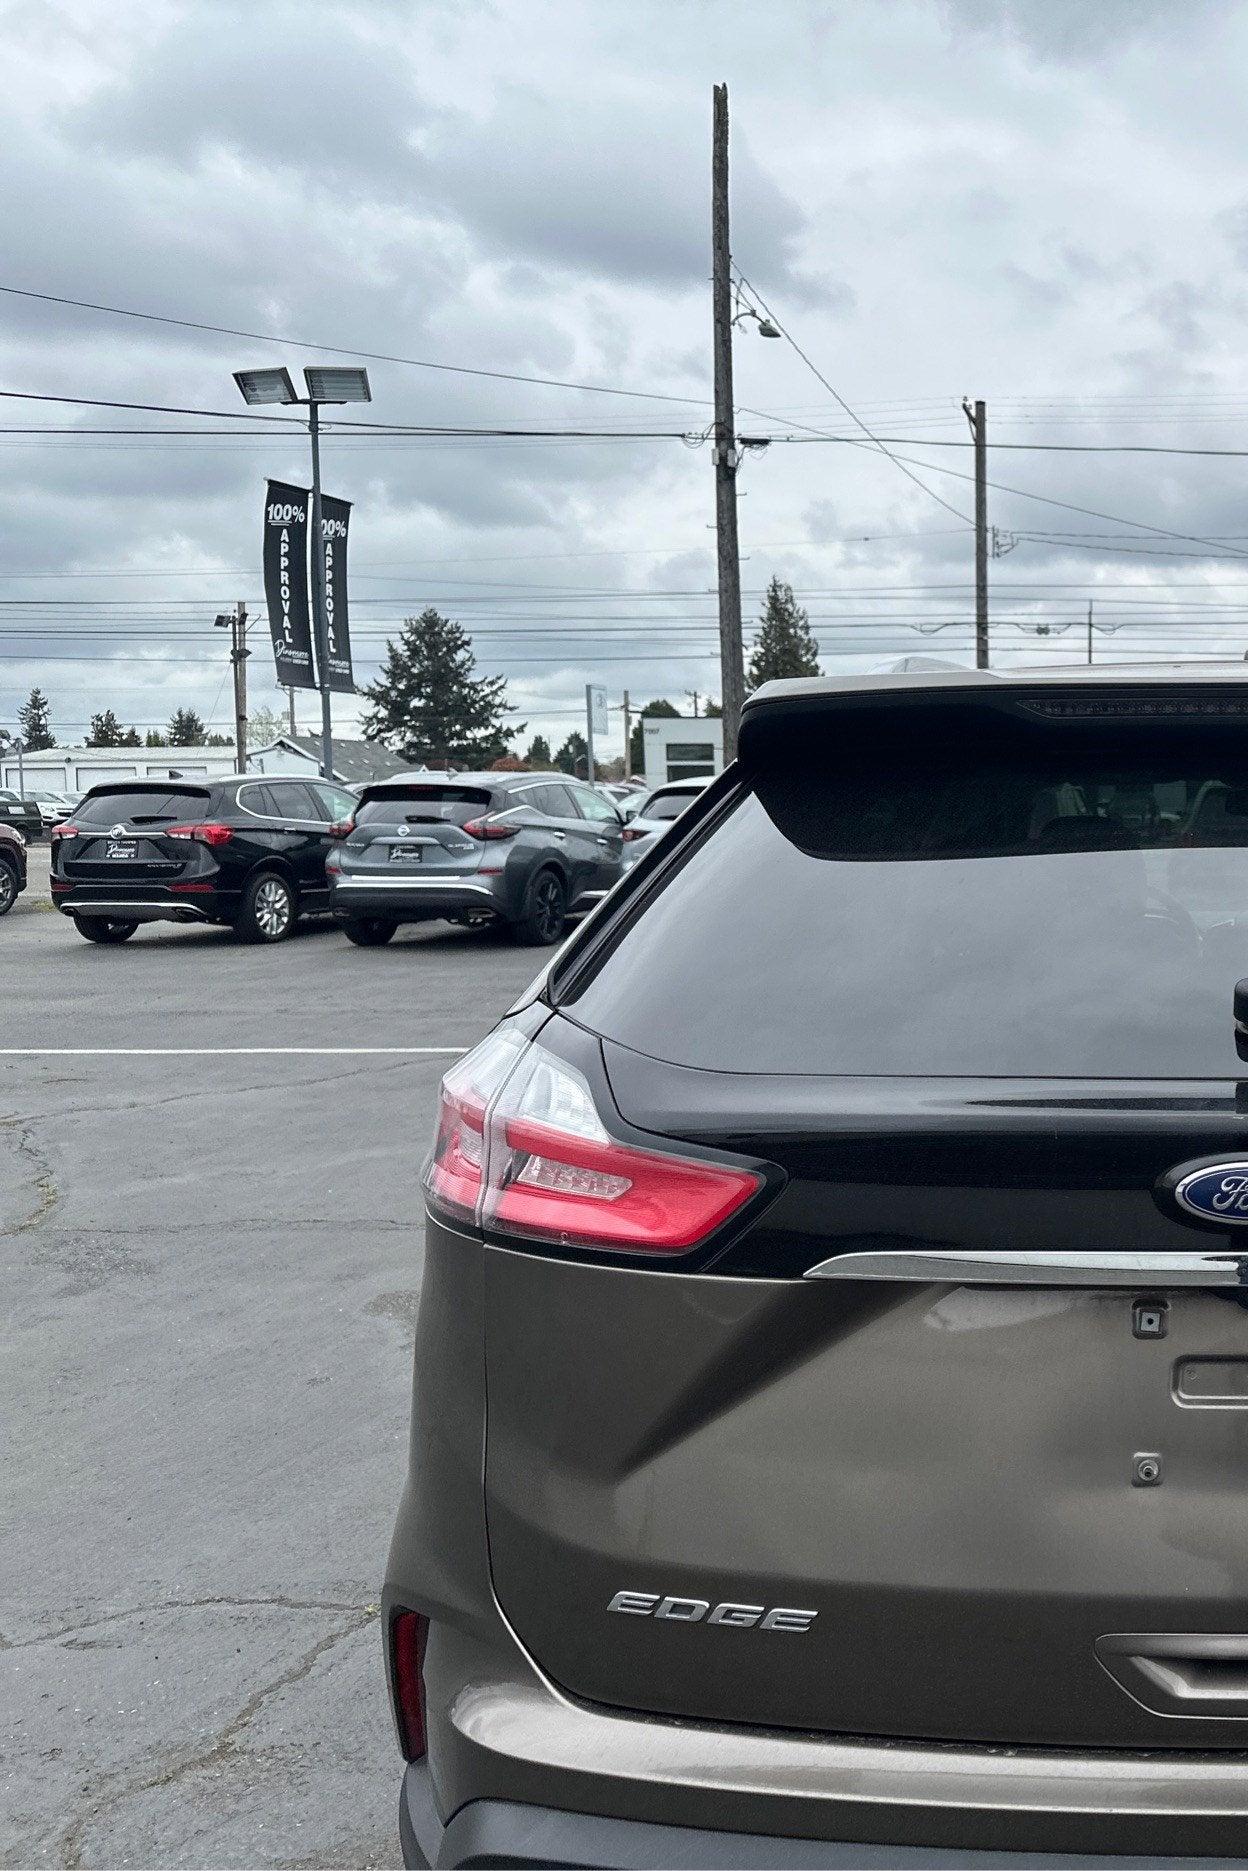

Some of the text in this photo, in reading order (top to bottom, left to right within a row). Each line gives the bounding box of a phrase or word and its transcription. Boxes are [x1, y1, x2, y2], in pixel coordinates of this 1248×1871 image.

[267, 503, 305, 523] 100%
[321, 518, 347, 538] 00%
[280, 528, 293, 643] APPROVAL
[325, 542, 337, 653] APPROVAL
[606, 1590, 819, 1633] EDGE
